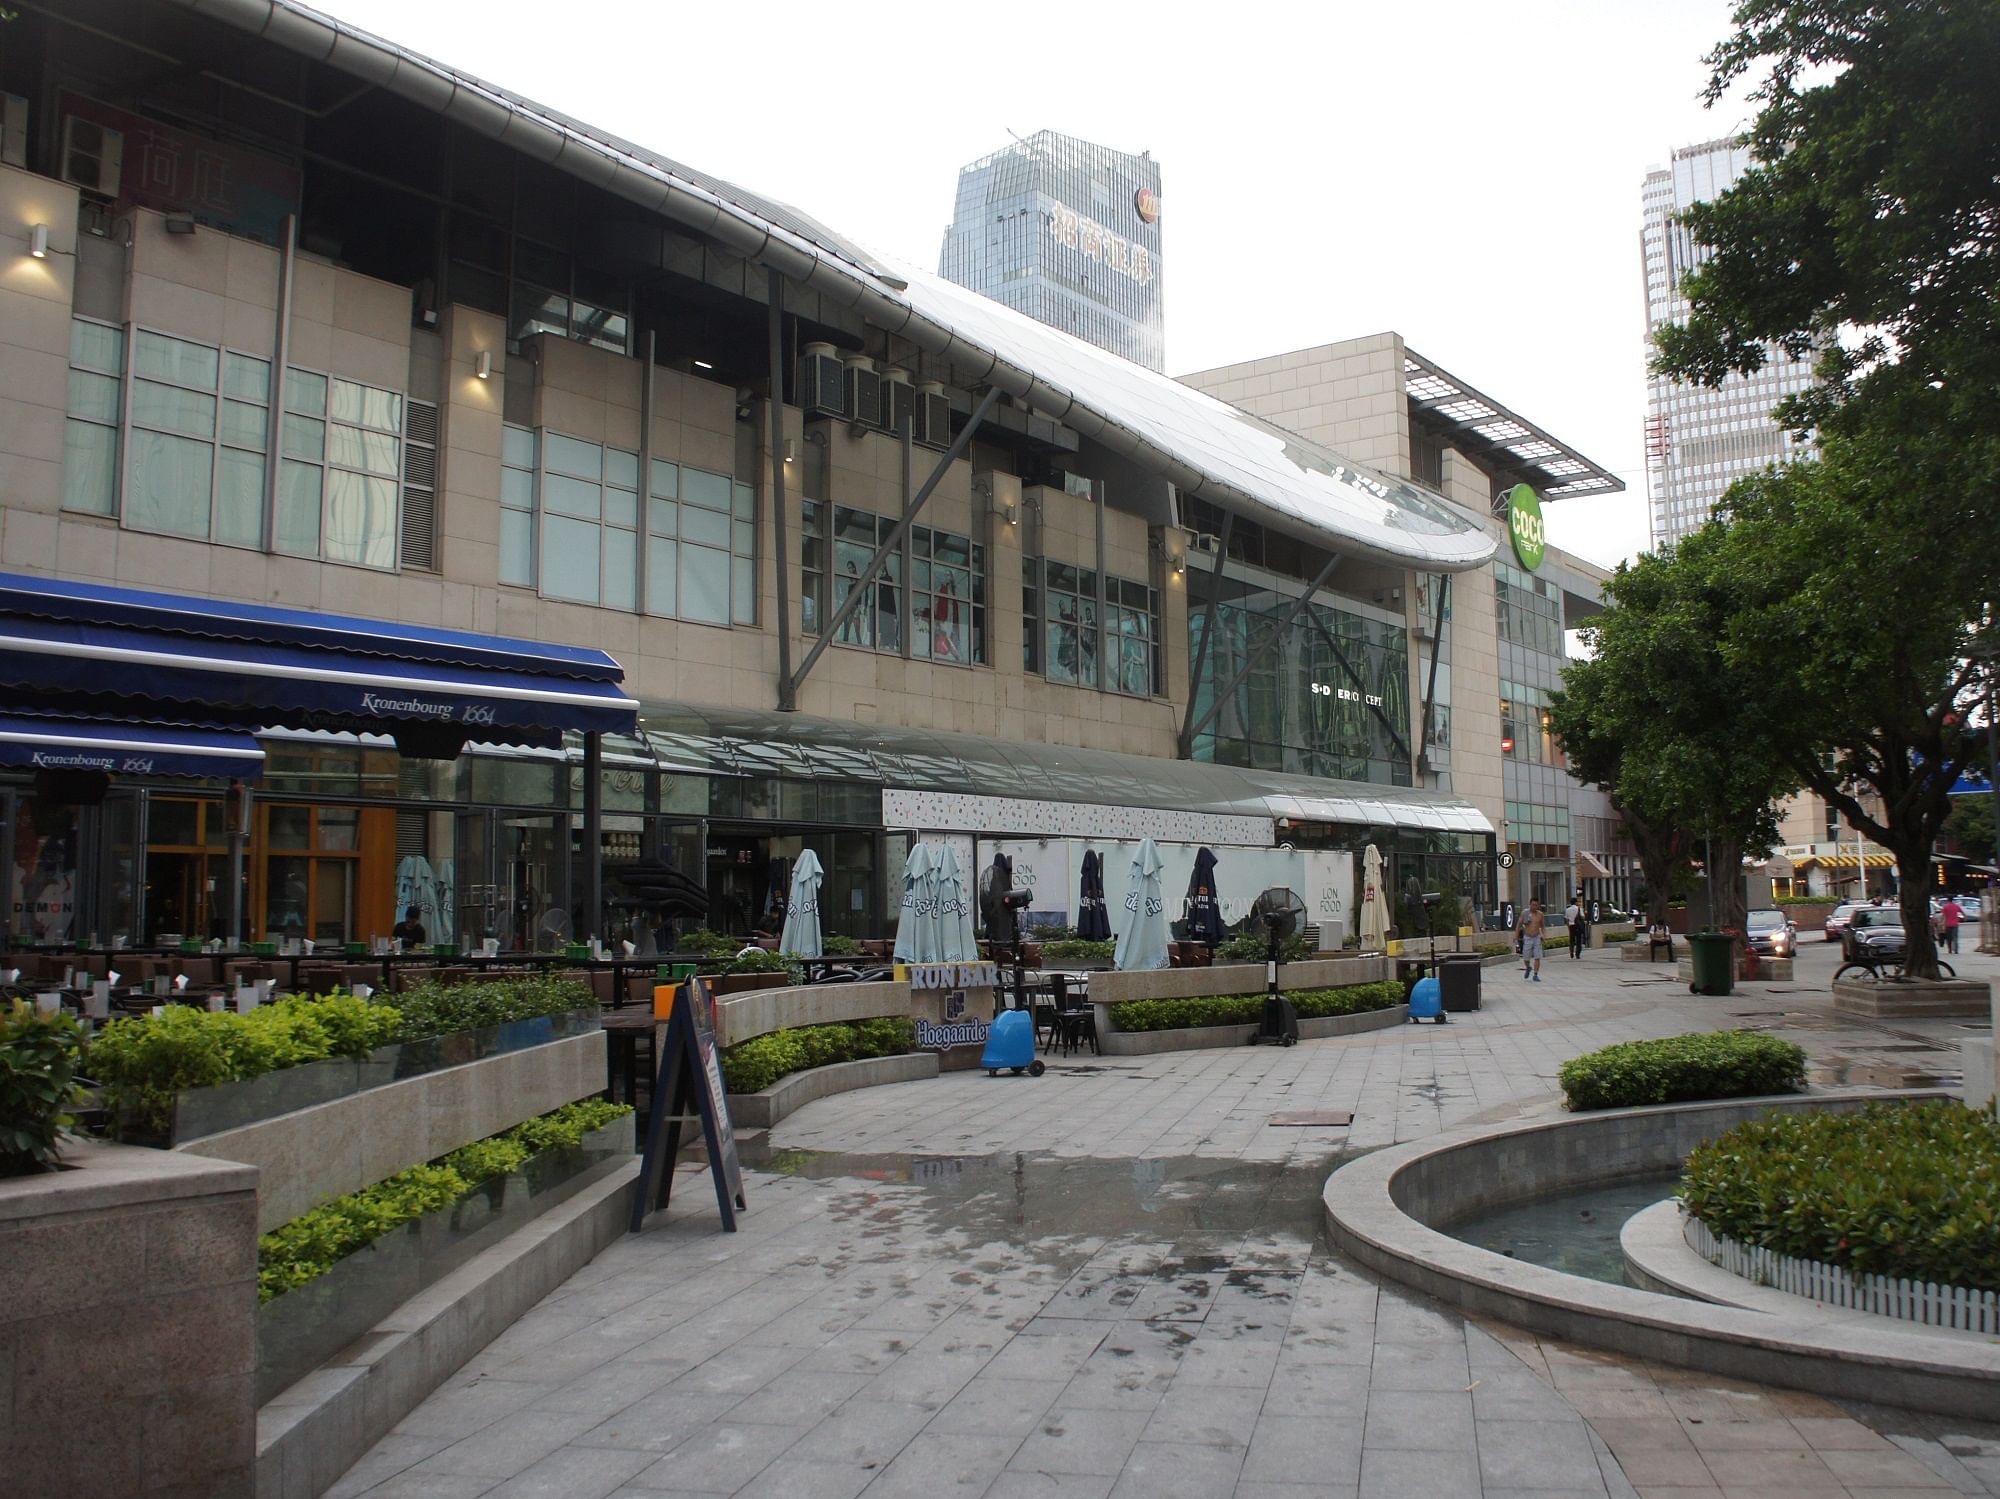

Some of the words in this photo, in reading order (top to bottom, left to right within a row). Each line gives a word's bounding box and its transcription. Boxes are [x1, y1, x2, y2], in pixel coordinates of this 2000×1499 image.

[1511, 506, 1545, 546] COCO
[361, 693, 454, 720] Kronenbourg
[462, 705, 496, 725] 1664
[32, 752, 115, 770] Kronenbourg
[1013, 875, 1037, 886] OOD
[1322, 887, 1338, 900] LON
[14, 903, 73, 913] DEMON
[1320, 900, 1341, 913] FOOD
[911, 966, 956, 989] RUN
[958, 964, 999, 987] BAR
